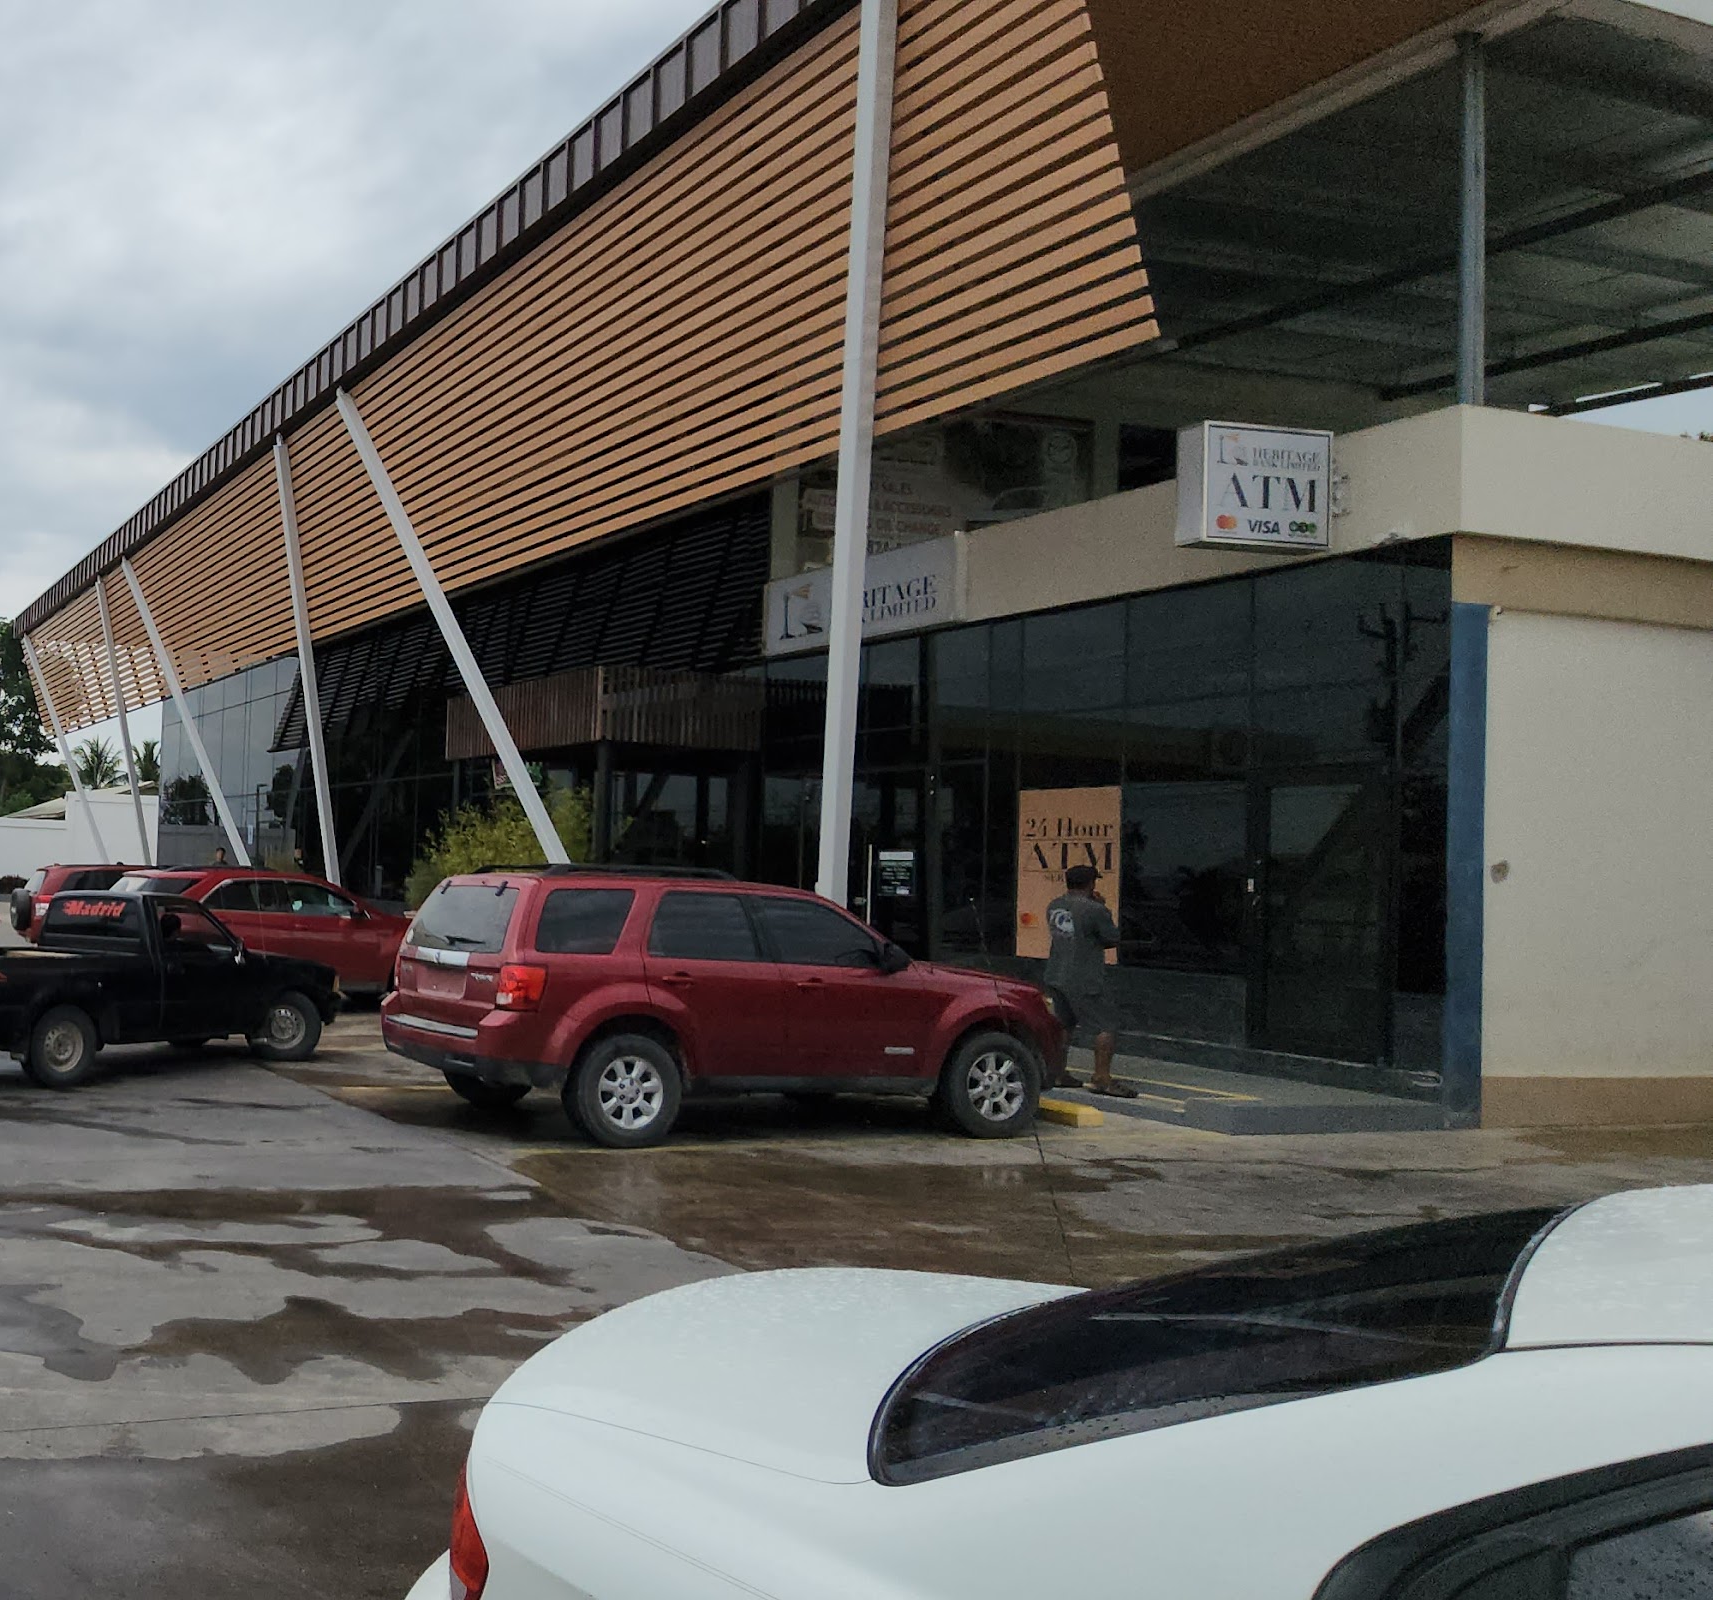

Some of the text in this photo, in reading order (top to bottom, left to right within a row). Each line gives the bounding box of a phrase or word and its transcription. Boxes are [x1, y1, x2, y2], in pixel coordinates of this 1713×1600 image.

[1252, 446, 1321, 463] HERITAGE
[1215, 472, 1318, 513] ATM
[1248, 519, 1281, 535] VISA
[863, 573, 937, 609] RITAGE
[1026, 817, 1115, 837] 24 Hour
[1027, 842, 1114, 871] ATM
[63, 900, 127, 918] Madrid
